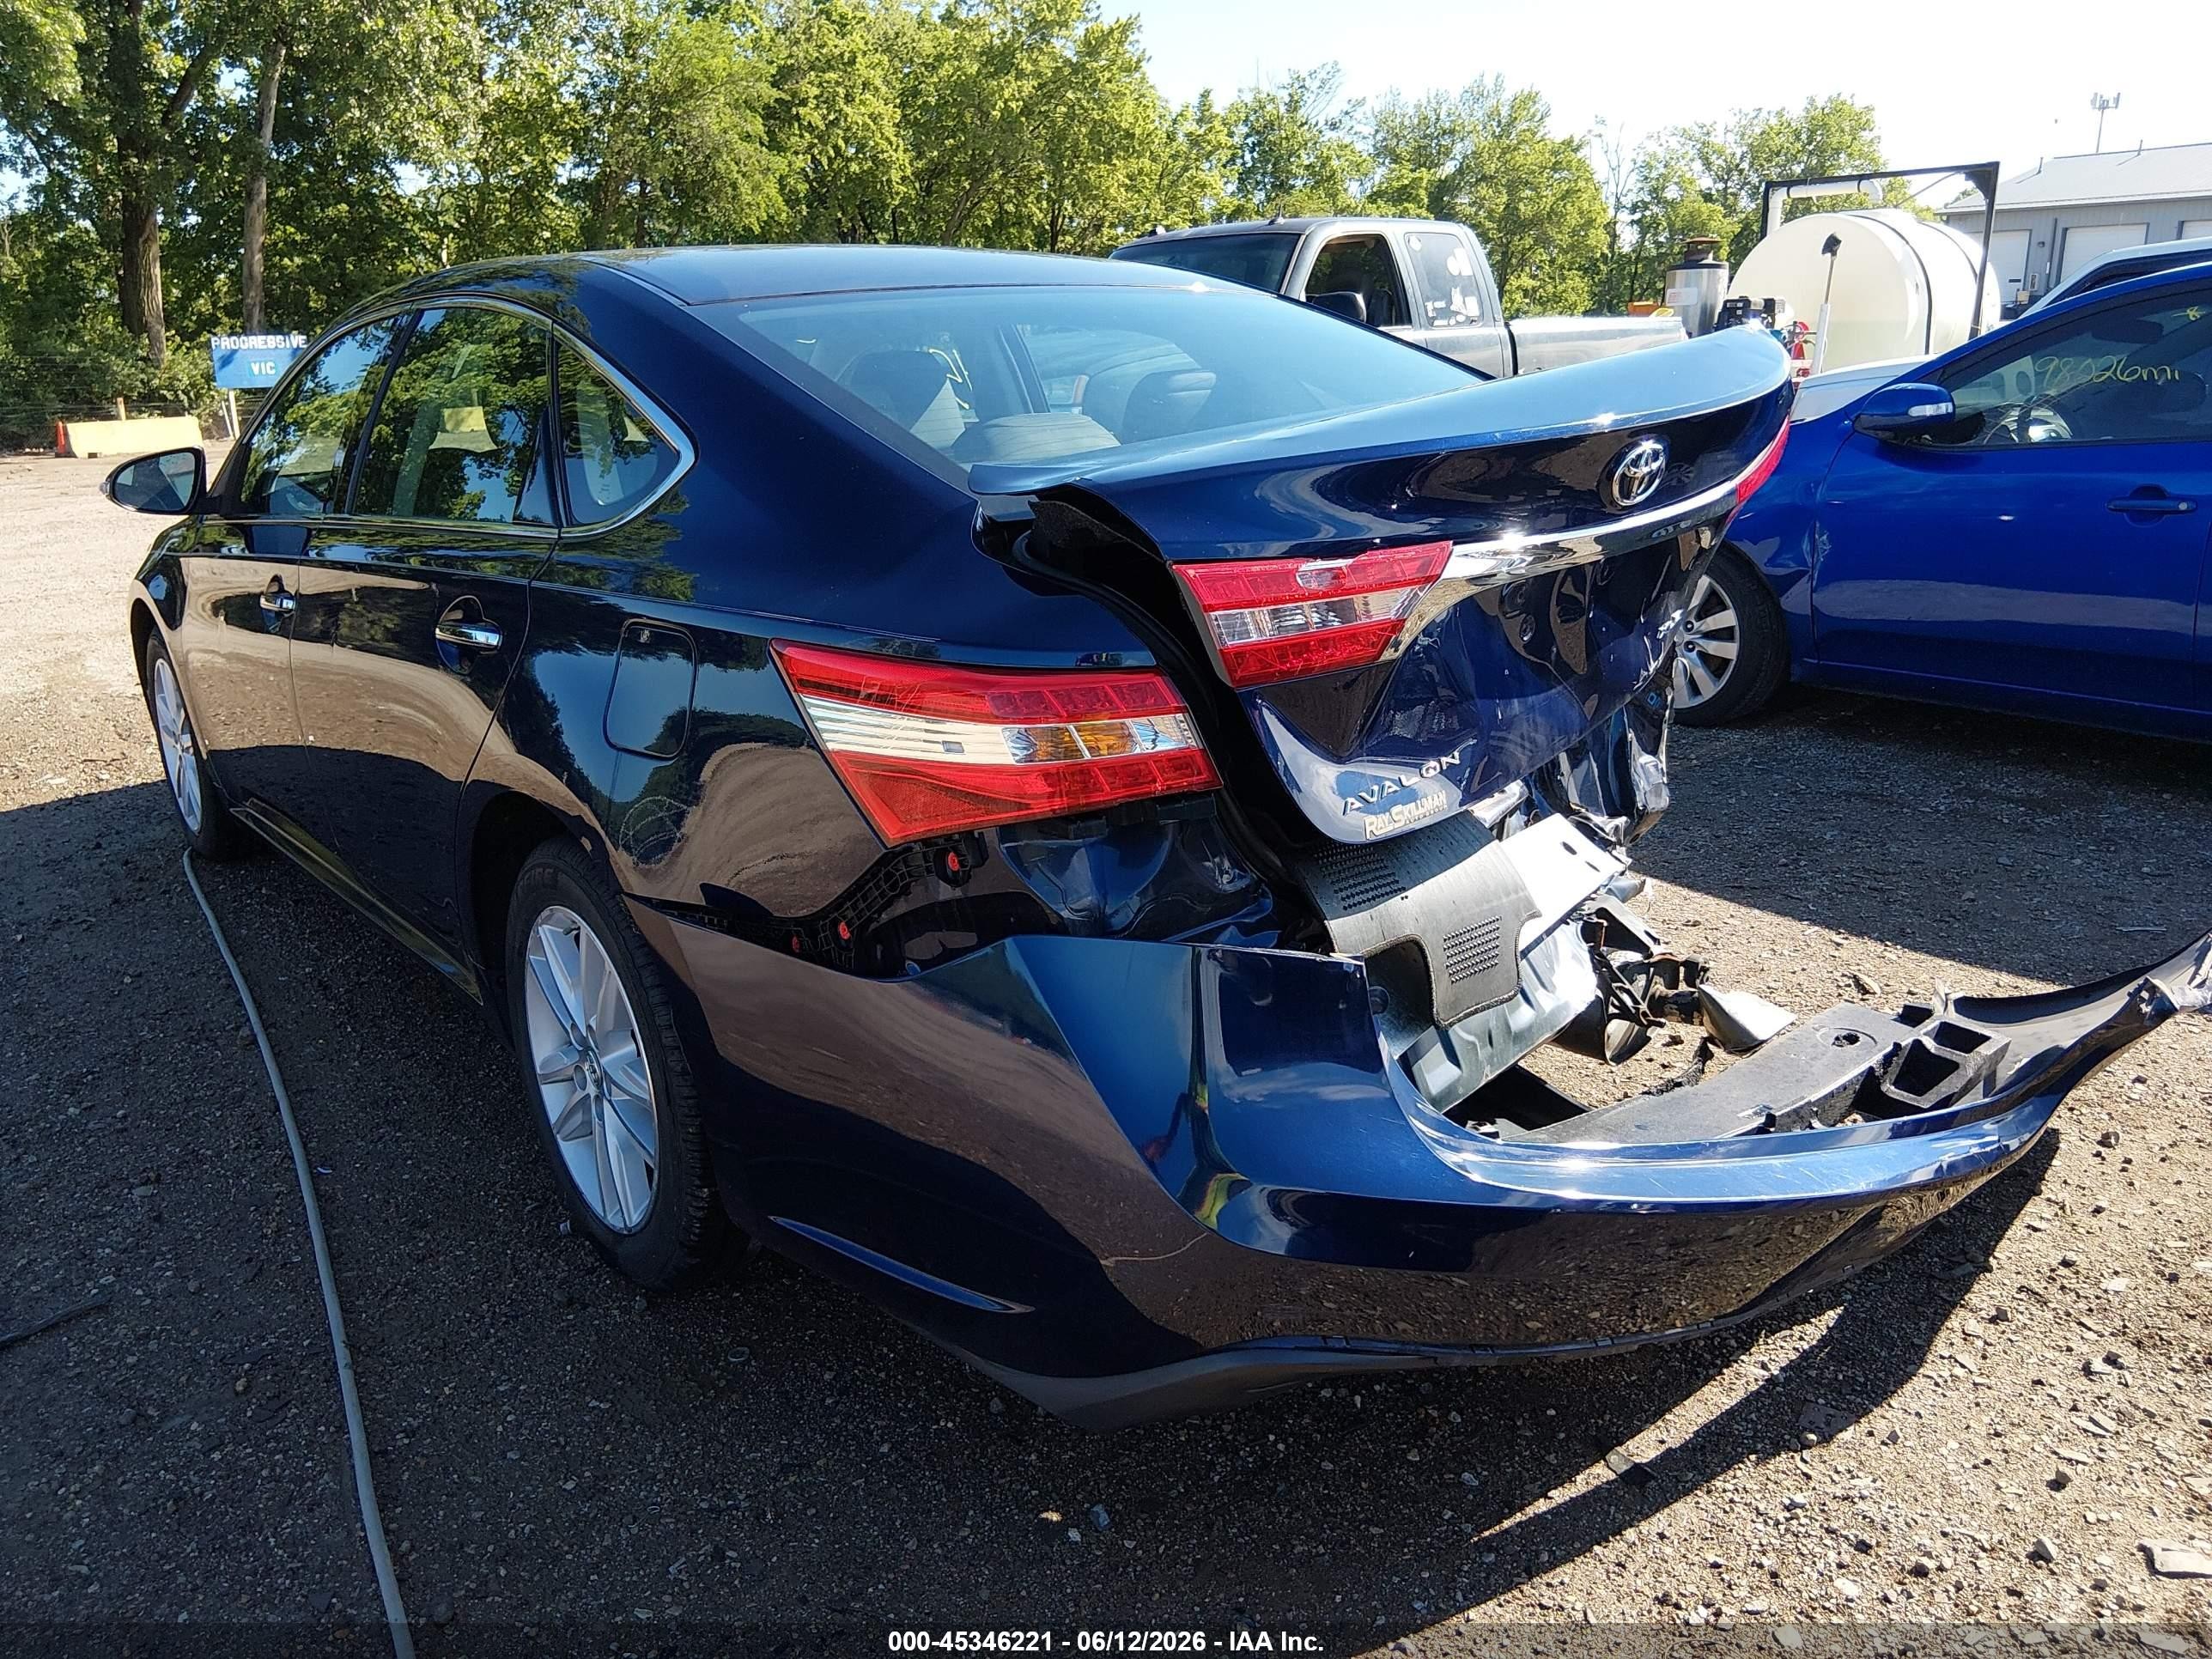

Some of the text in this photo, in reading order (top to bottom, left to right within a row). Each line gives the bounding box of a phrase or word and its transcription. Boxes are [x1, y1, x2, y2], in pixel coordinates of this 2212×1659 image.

[211, 335, 307, 349] PROGRESSIVE
[251, 362, 276, 374] VIC
[1342, 750, 1461, 816] AVALON
